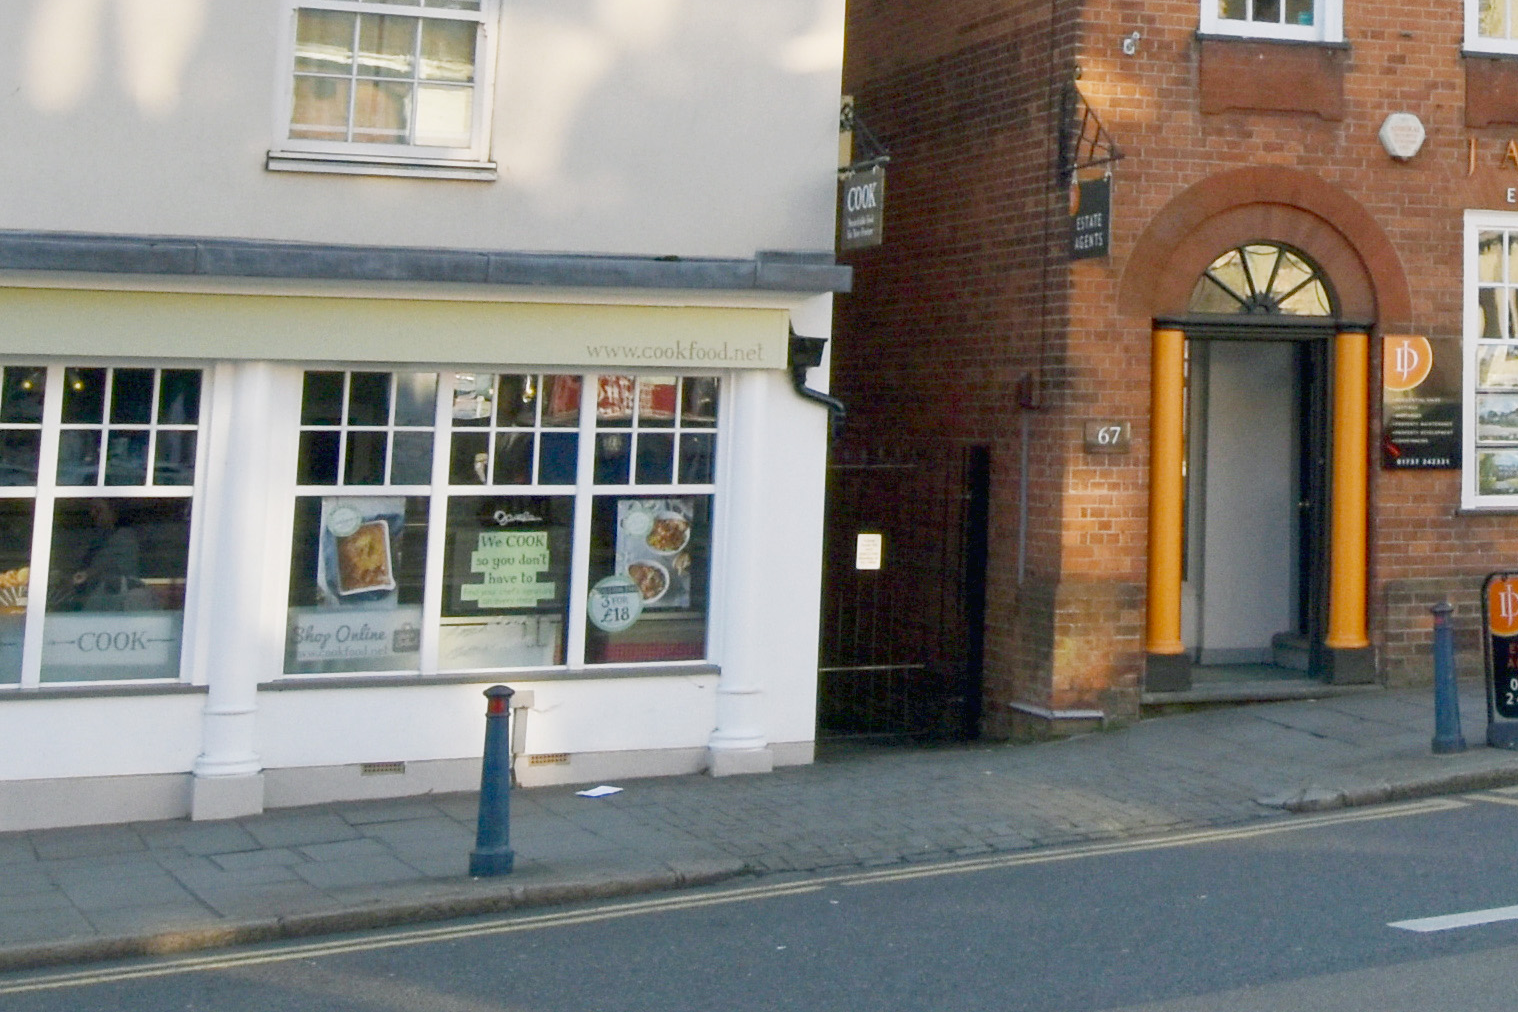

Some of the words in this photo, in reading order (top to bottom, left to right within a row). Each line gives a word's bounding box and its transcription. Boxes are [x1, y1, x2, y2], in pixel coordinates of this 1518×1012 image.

[847, 181, 878, 213] COOK
[1076, 213, 1103, 231] ESTATE
[1074, 232, 1104, 250] AGENTS
[586, 340, 765, 362] www.cookfood.net
[1098, 426, 1121, 444] 67
[481, 535, 502, 547] We
[506, 534, 546, 547] COOK
[476, 556, 489, 566] so
[492, 555, 515, 570] you
[518, 553, 548, 566] don't
[488, 572, 518, 584] have
[521, 571, 533, 583] to
[601, 593, 611, 608] 3
[600, 606, 630, 623] £18
[78, 631, 149, 652] COOK
[293, 624, 332, 650] Shop
[335, 623, 387, 643] Online
